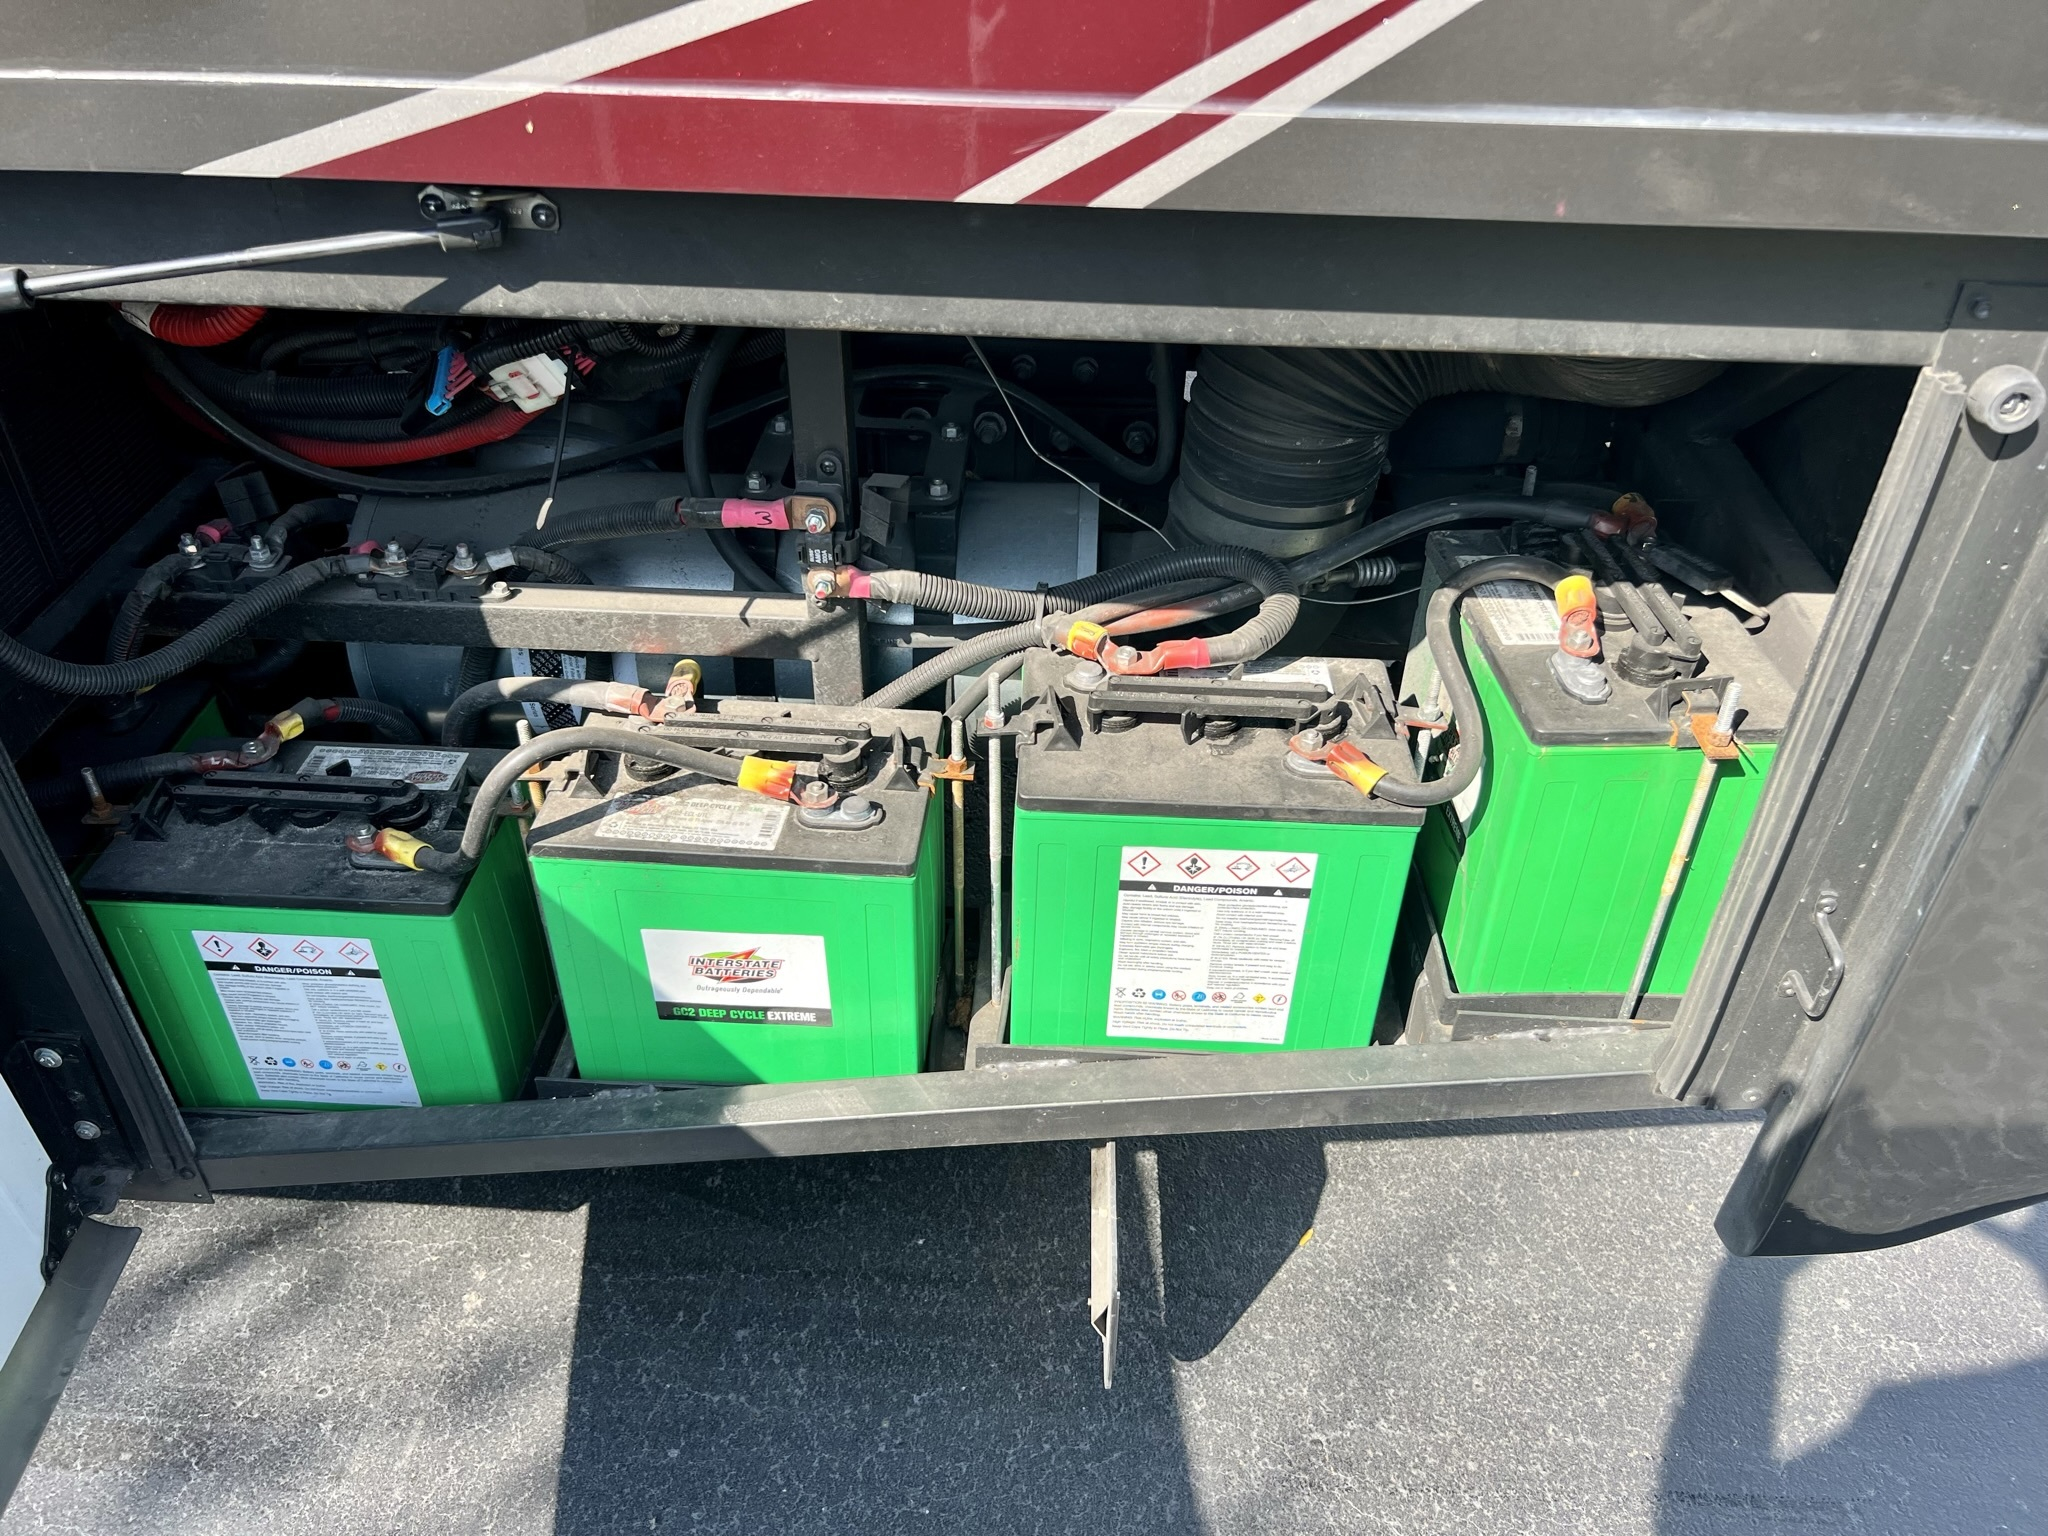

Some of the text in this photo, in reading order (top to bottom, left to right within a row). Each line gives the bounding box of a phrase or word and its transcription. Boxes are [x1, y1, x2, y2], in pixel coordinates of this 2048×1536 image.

[755, 511, 772, 526] 3
[1173, 884, 1258, 895] DANGER/POISON
[690, 958, 780, 968] INTERSTATE
[254, 966, 332, 975] DANGER/POISON
[694, 967, 774, 977] BATTERIES
[696, 984, 740, 994] Outrageously
[673, 1007, 816, 1022] GC2 DEEP CYCLE EXTREME
